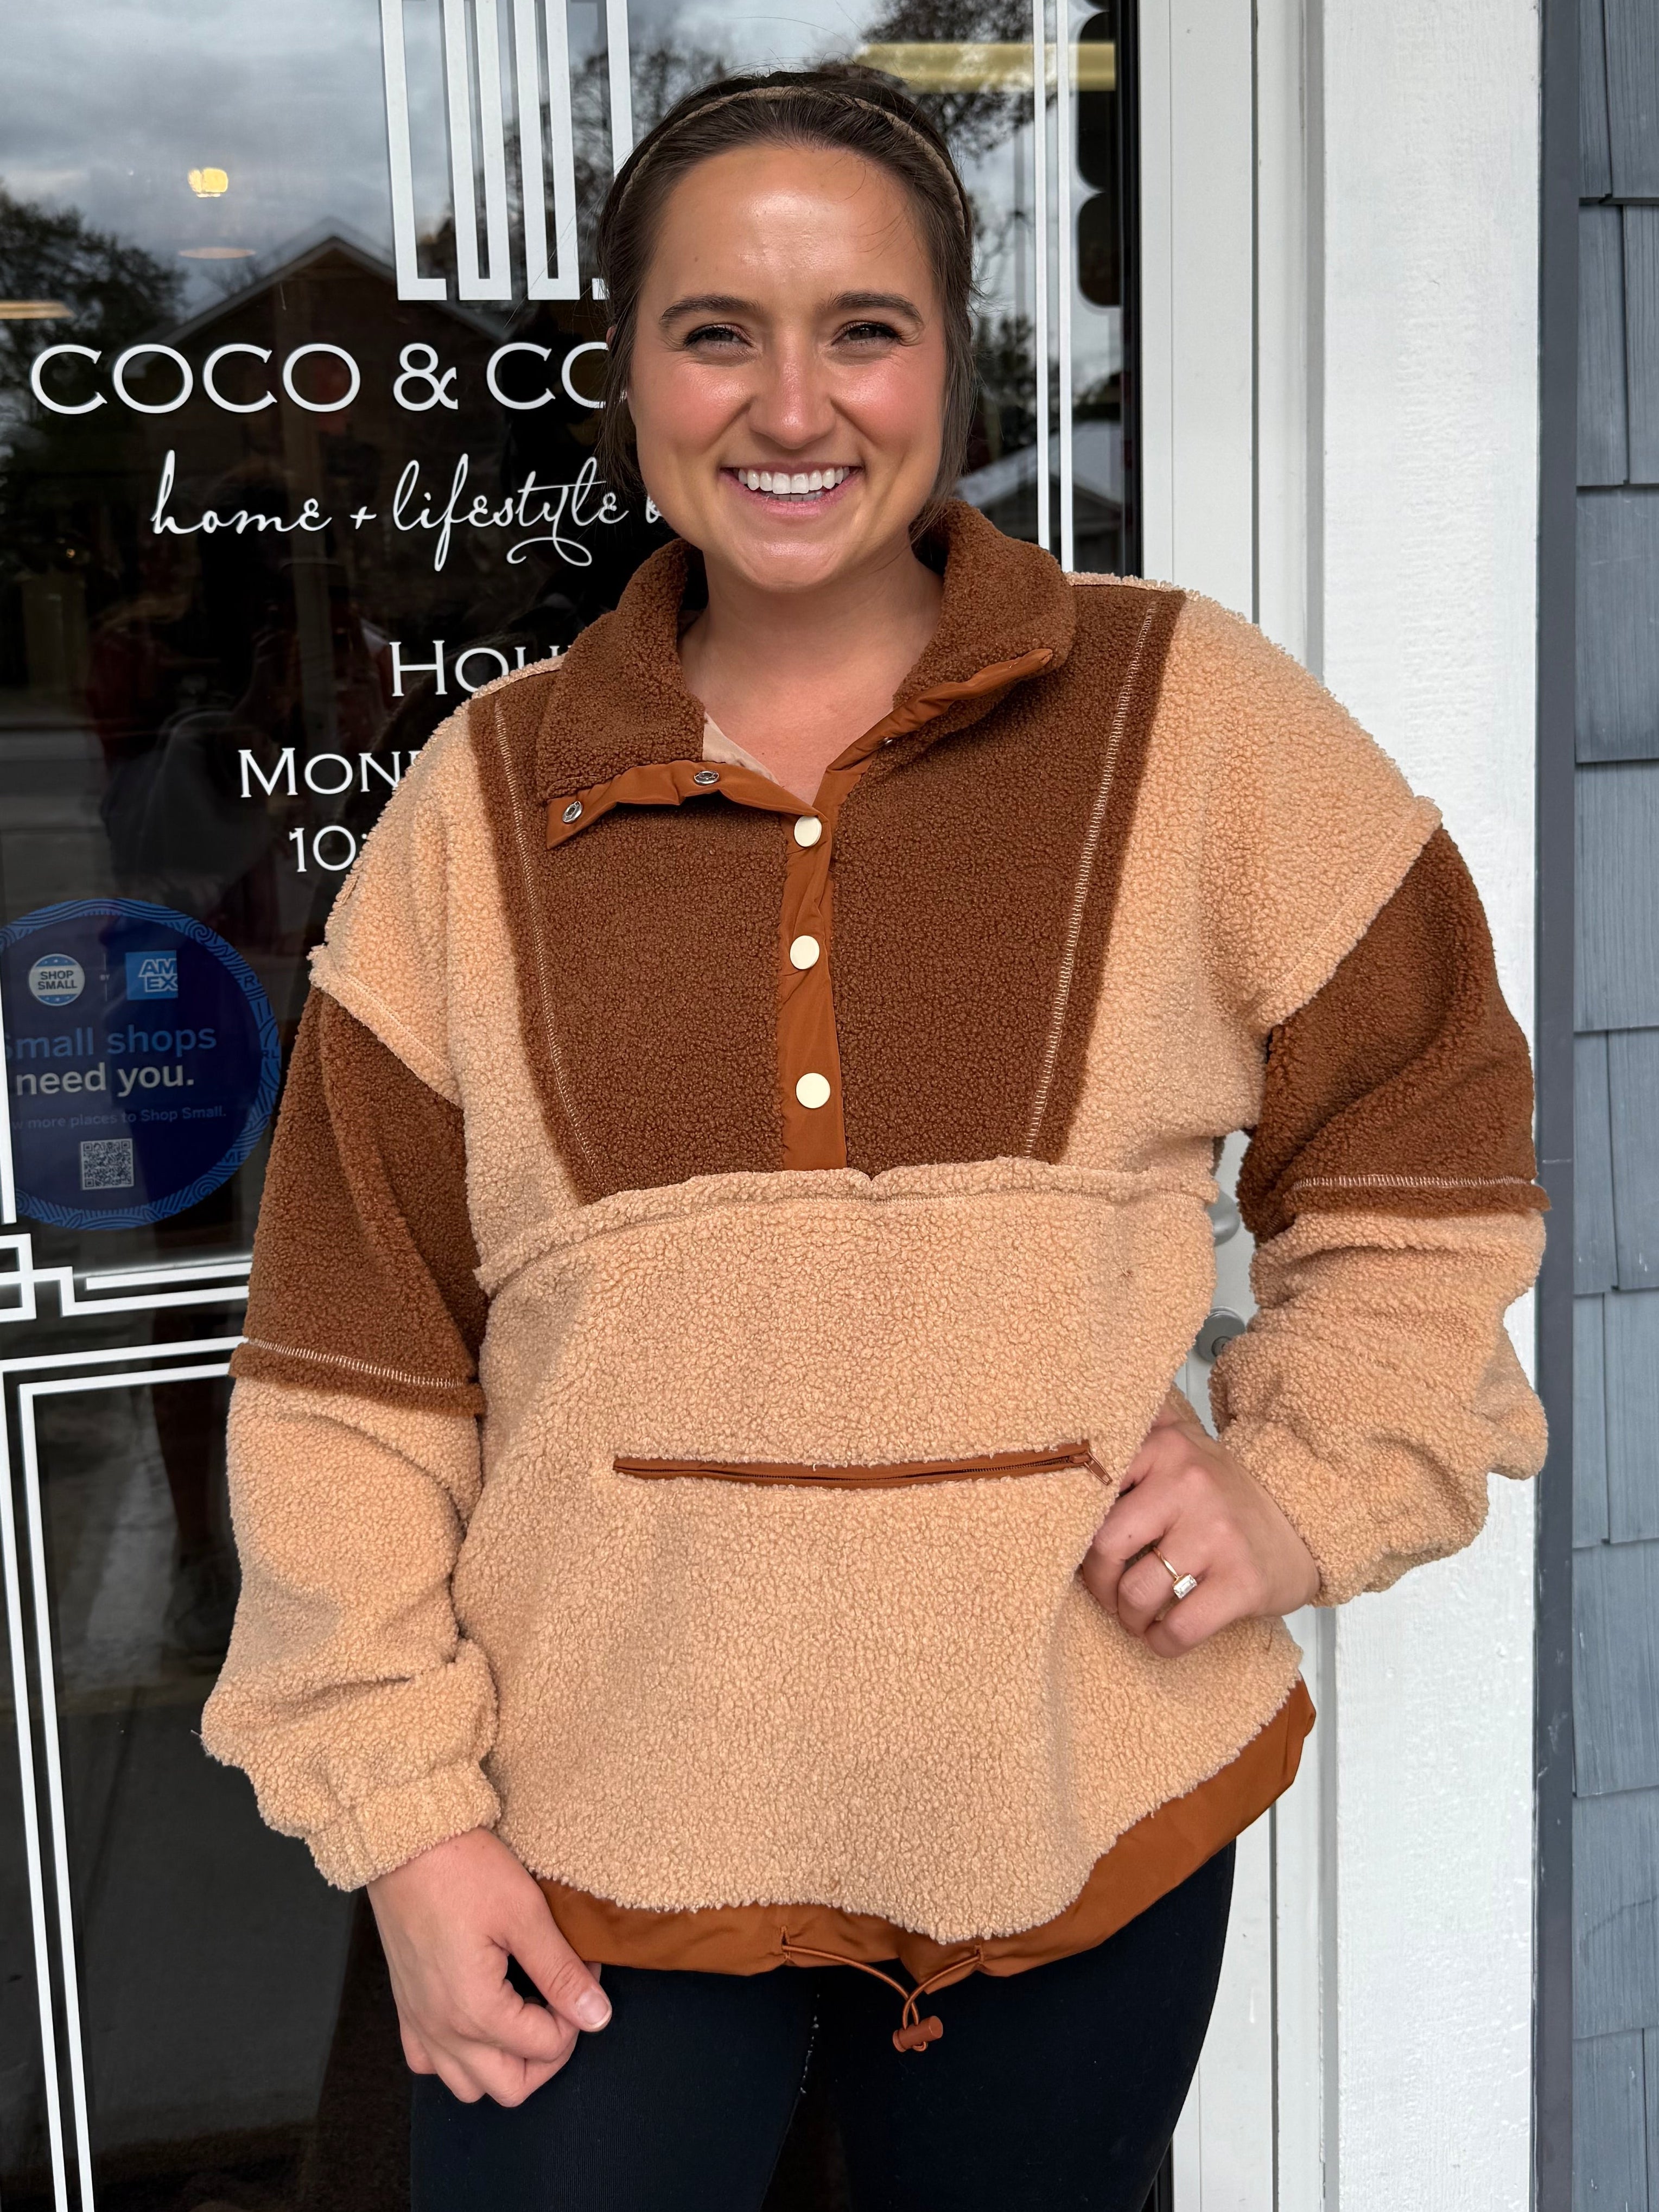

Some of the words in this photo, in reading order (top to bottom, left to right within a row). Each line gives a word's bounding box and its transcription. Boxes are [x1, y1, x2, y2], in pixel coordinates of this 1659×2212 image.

[30, 343, 360, 415] COCO
[393, 343, 459, 411] &
[151, 449, 332, 534] home
[350, 506, 377, 530] +
[393, 453, 630, 571] lifestyle
[37, 980, 78, 990] SMALL
[40, 970, 74, 980] SHOP
[107, 1024, 217, 1057] shops
[17, 1062, 106, 1095] need
[118, 1065, 194, 1097] you.
[28, 1118, 66, 1129] more
[71, 1114, 118, 1129] places
[121, 1111, 137, 1123] to
[141, 1109, 178, 1122] Shop
[182, 1105, 227, 1119] Small.
